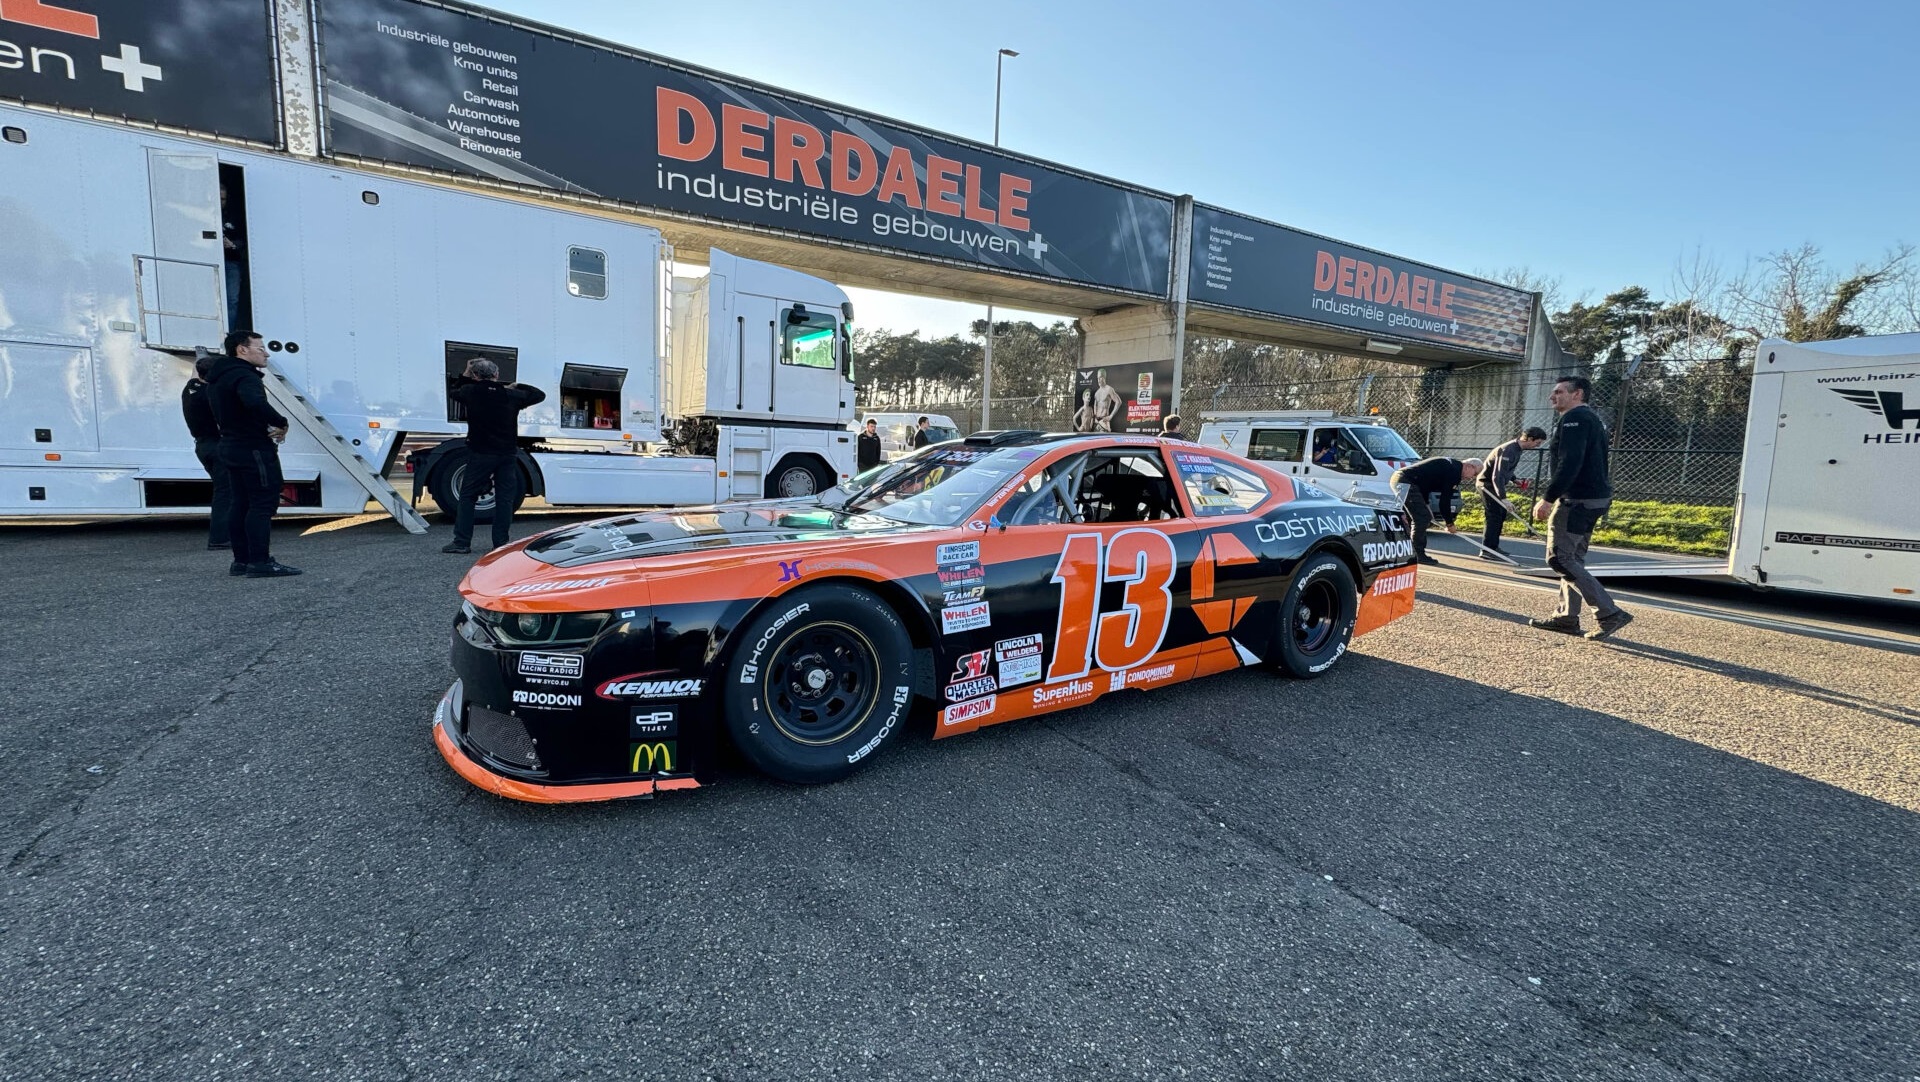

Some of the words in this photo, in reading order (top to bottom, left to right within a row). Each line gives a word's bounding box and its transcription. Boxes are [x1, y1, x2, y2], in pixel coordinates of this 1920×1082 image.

[377, 21, 449, 48] Industriële
[453, 41, 517, 64] gebouwen
[453, 55, 483, 72] Kmo
[487, 67, 518, 80] units
[482, 78, 518, 96] Retail
[463, 90, 519, 112] Carwash
[448, 103, 520, 128] Automotive
[447, 119, 521, 143] Warehouse
[460, 138, 522, 159] Renovatie
[656, 85, 1032, 232] DERDAELE
[657, 163, 859, 224] industriële
[872, 212, 1020, 256] gebouwen
[1314, 250, 1455, 318] DERDAELE
[1311, 293, 1384, 323] industriële
[1388, 310, 1448, 334] gebouwen
[1255, 513, 1377, 543] COSTAMARE
[1378, 514, 1404, 532] INC.
[950, 543, 974, 553] NASCAR
[1777, 533, 1825, 545] RACE
[1377, 539, 1414, 561] DODONI
[937, 566, 985, 582] WHELEN
[944, 604, 987, 621] WHELEN
[1045, 527, 1177, 685] 13
[749, 602, 811, 665] HOOSIER
[998, 636, 1034, 652] LINCOLN
[1006, 645, 1038, 658] WELDERS
[521, 664, 547, 673] RACING
[549, 667, 579, 675] RADIOS
[522, 654, 580, 666] SYCO
[526, 677, 570, 686] WWW.SYCO.EU
[1127, 664, 1176, 683] CONDOMINIUM
[603, 679, 702, 695] KENNOL
[640, 691, 690, 699] PERFORMANCE
[946, 677, 993, 697] QUARTER
[955, 684, 995, 701] MASTER
[529, 692, 582, 706] DODONI
[949, 698, 993, 721] SIMPSON
[846, 703, 903, 764] HOOSIER
